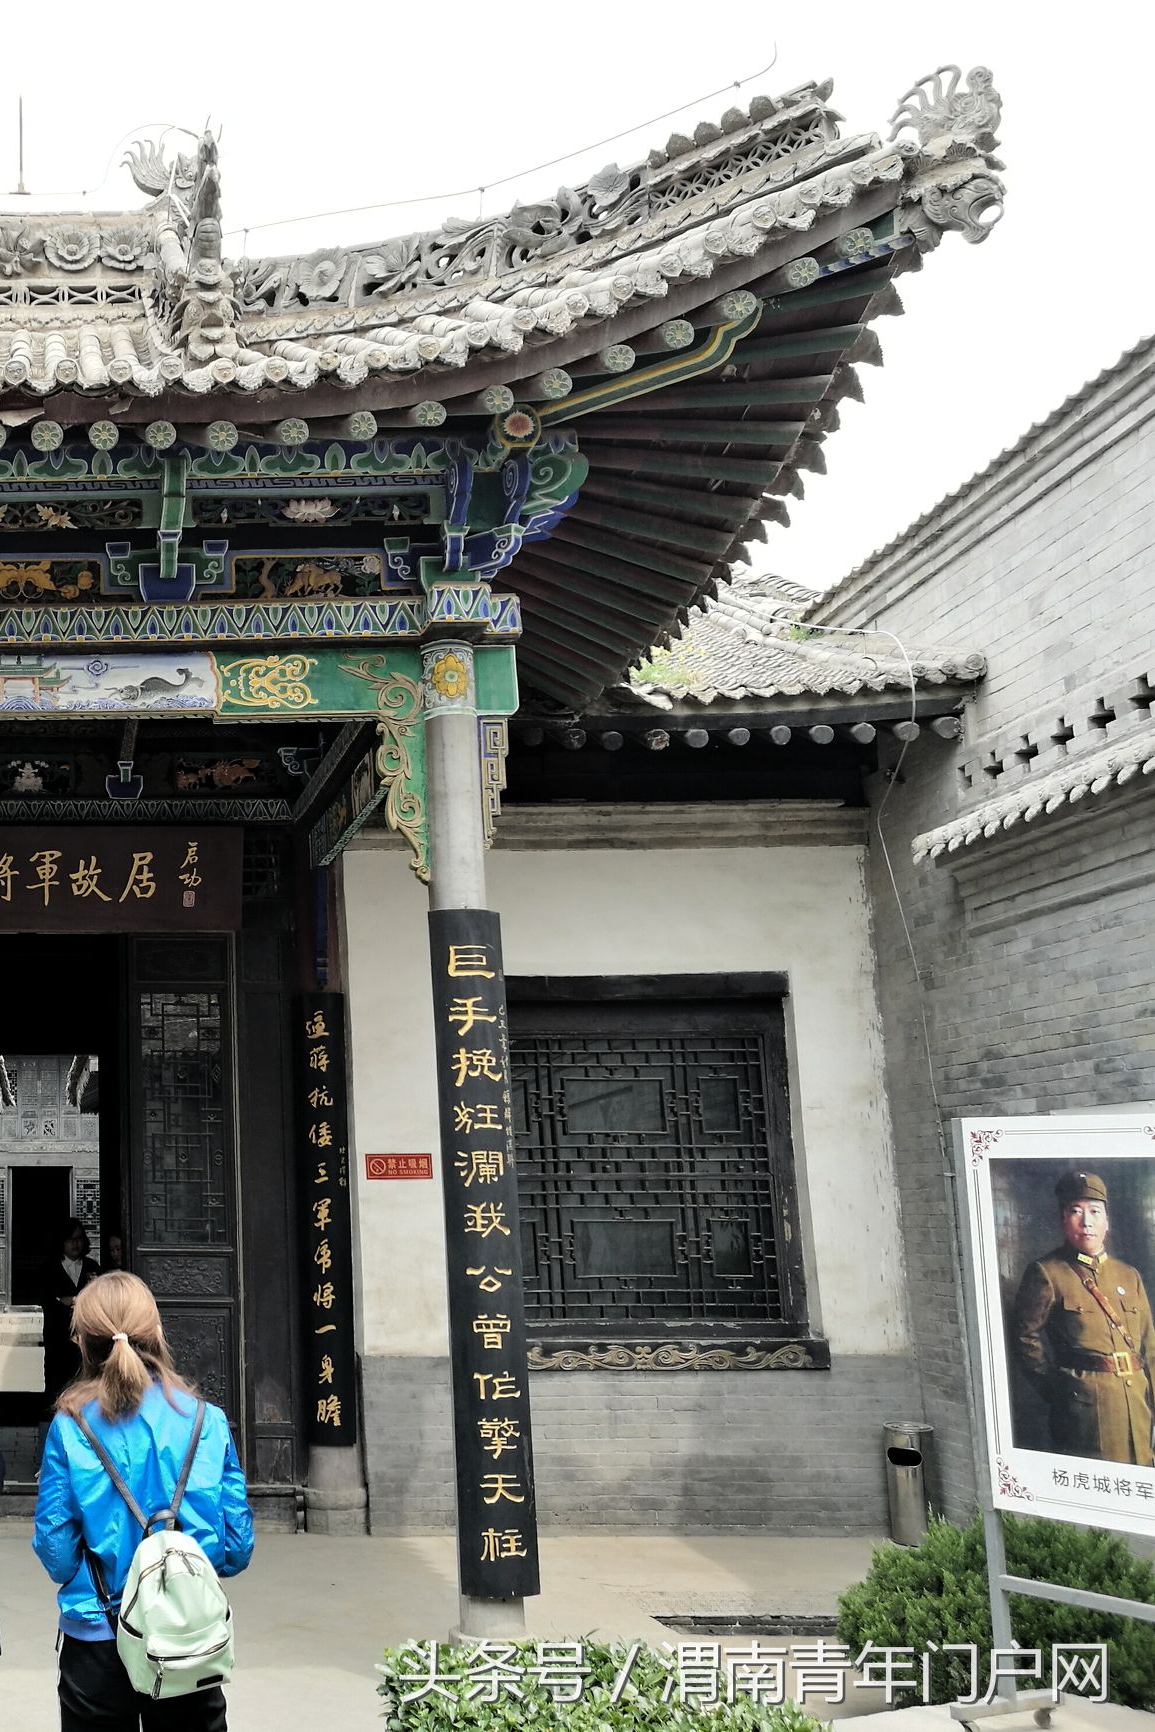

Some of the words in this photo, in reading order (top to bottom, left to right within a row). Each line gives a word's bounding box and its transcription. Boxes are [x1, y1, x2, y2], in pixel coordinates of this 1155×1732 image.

[387, 1158, 428, 1169] 禁止吸烟
[1052, 1467, 1155, 1500] 杨虎城将军
